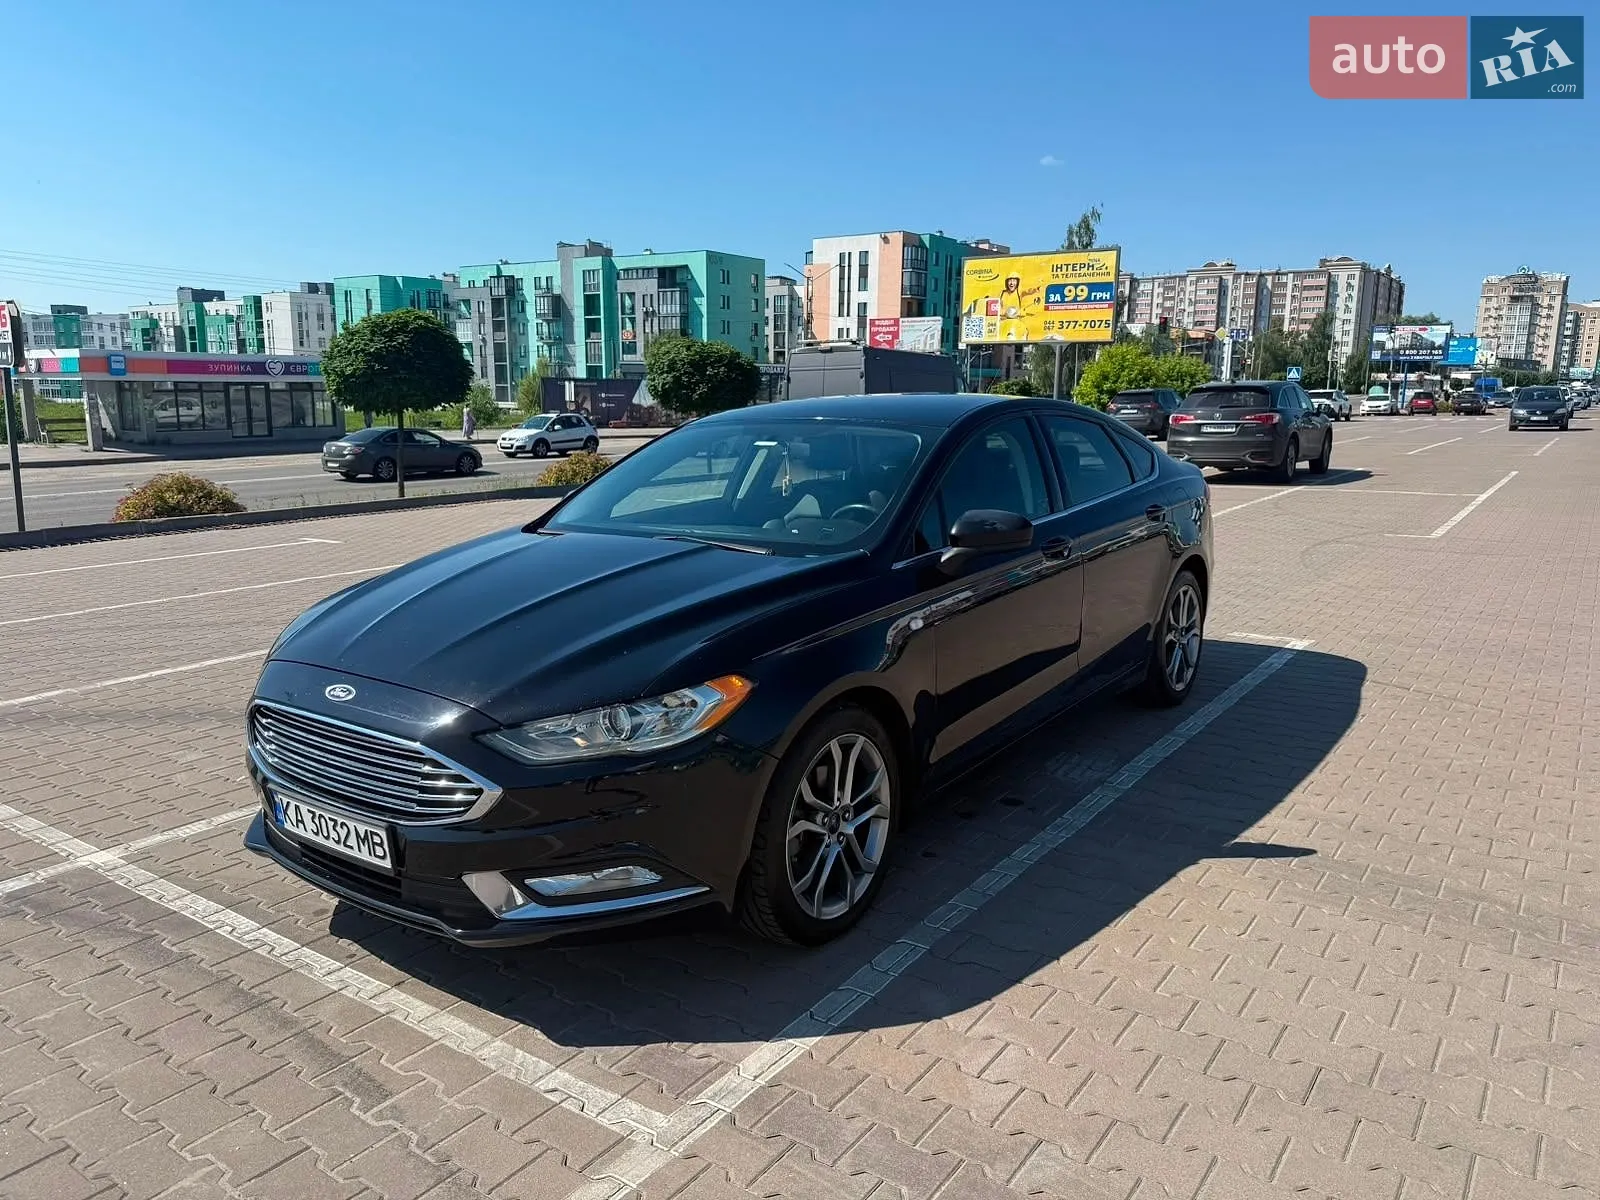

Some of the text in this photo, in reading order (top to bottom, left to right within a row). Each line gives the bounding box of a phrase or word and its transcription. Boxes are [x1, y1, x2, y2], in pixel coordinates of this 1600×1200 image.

[1049, 285, 1111, 302] ЗА 99 ГРН
[1058, 319, 1111, 329] 377-7075
[208, 364, 323, 373] ЗУПИНКА ЄВРОП
[306, 808, 354, 850] 3032
[354, 824, 387, 859] MB
